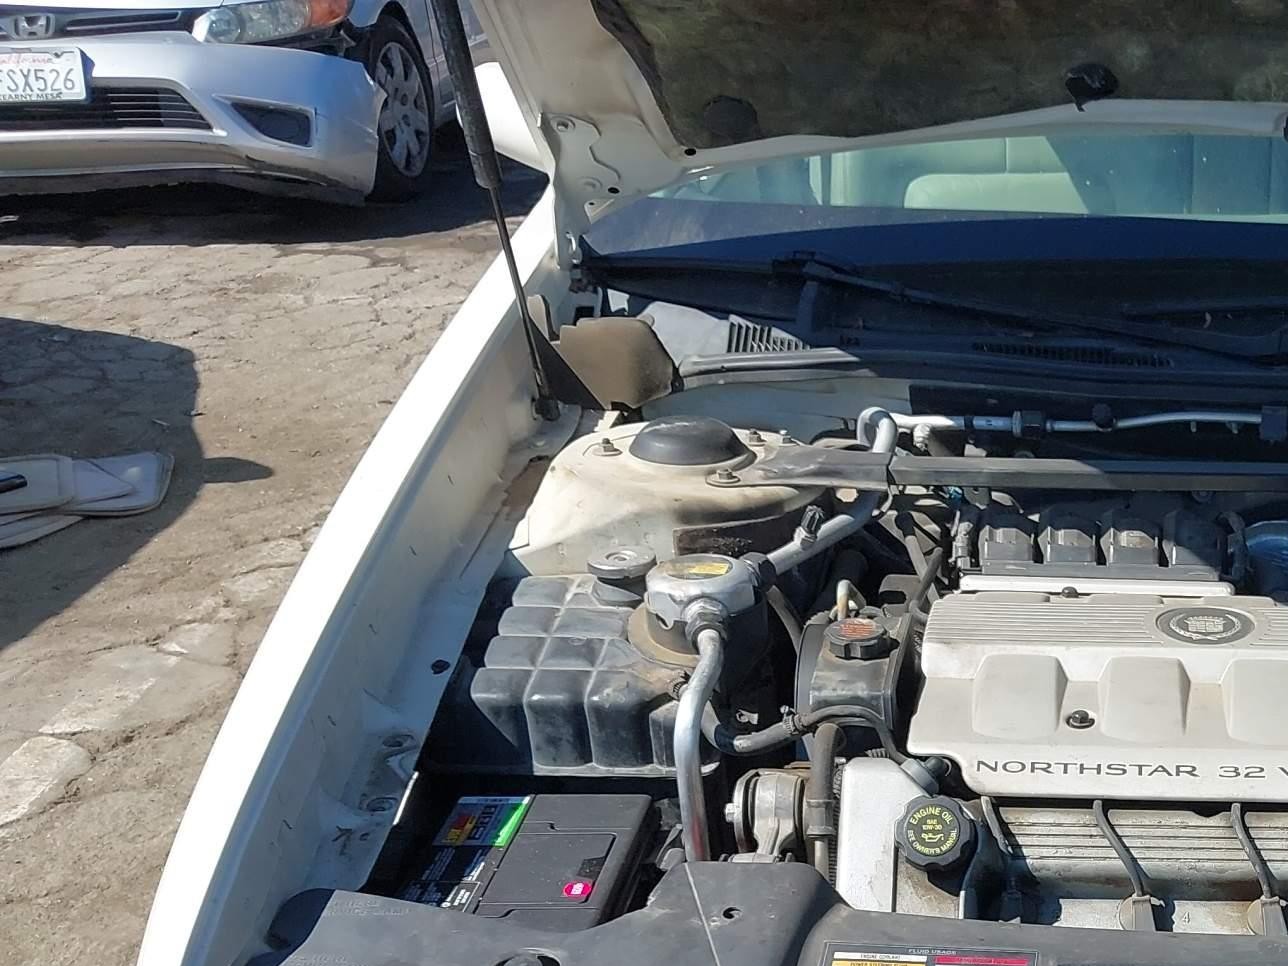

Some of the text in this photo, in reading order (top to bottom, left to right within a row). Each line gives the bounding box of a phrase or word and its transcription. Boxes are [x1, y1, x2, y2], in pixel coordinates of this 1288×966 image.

[976, 760, 1201, 778] NORTHSTAR
[1217, 766, 1267, 779] 32
[910, 806, 953, 825] ENGINE OIL
[940, 828, 957, 852] MANUAL
